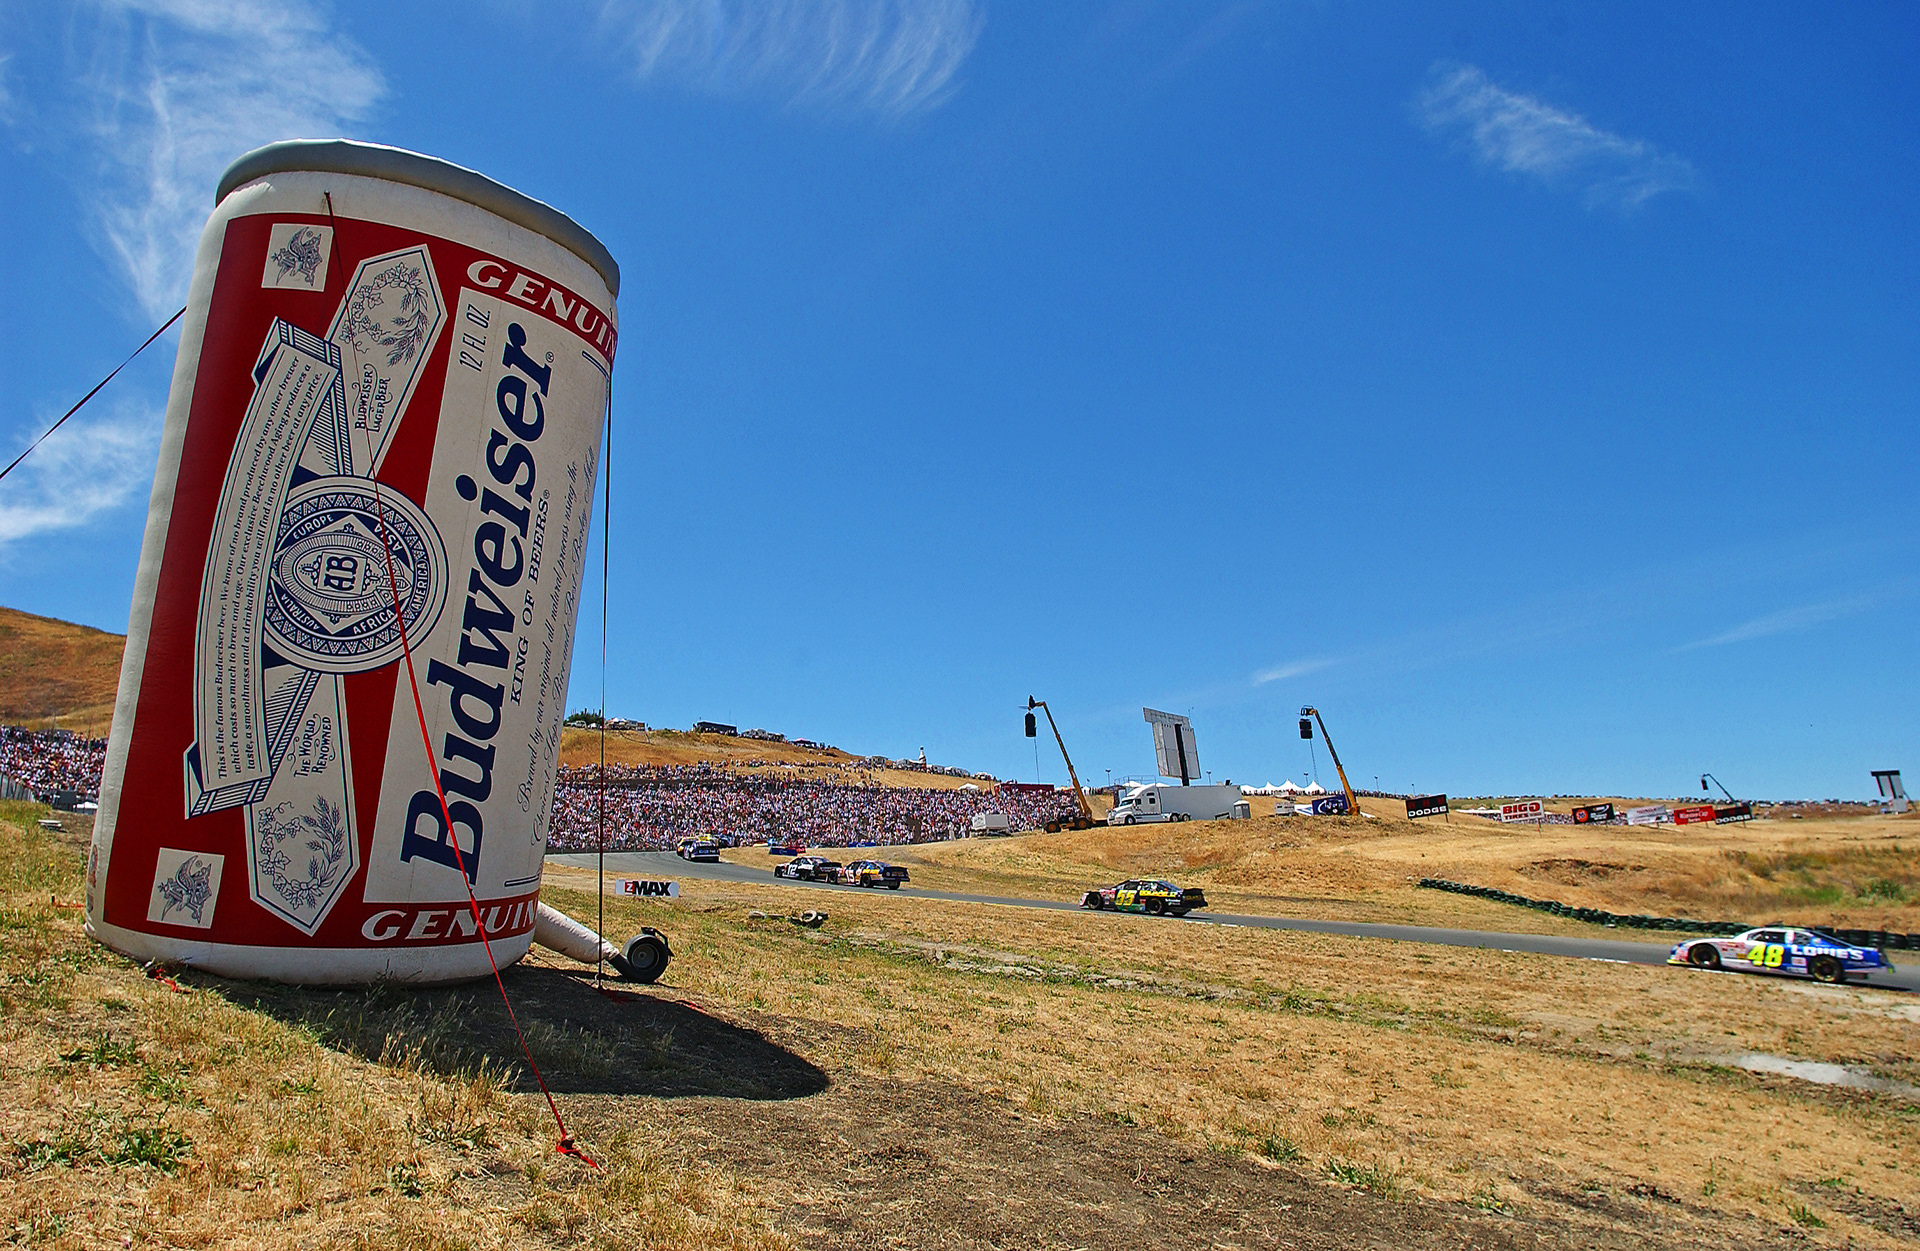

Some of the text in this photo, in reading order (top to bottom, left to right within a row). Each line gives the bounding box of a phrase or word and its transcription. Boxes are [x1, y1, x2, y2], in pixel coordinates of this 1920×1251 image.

[459, 303, 491, 372] 12 FL. OZ.
[306, 373, 323, 400] price.
[354, 370, 374, 429] BUDWEISER
[297, 398, 310, 418] any
[366, 377, 391, 433] LAGER BEER
[292, 418, 301, 430] at
[282, 430, 295, 452] beer
[274, 452, 287, 480] other
[567, 460, 578, 483] the
[265, 496, 274, 507] in
[270, 481, 279, 495] no
[564, 484, 577, 522] using
[259, 506, 270, 528] find
[292, 514, 335, 540] EUROPE
[255, 529, 266, 550] will
[374, 522, 403, 551] ASIA
[215, 356, 299, 779] This is the famous Budweiser beer. We know of no brand produced by any other brewer
[228, 364, 312, 773] which costs so much to brew and age. Our exclusive Beechwood Aging produces a
[252, 551, 261, 572] you
[414, 562, 428, 610] AMERICA
[550, 567, 562, 622] natural
[242, 573, 259, 634] drinkability
[280, 592, 321, 631] AUSTRALIA
[400, 322, 552, 887] Budweiser
[510, 497, 549, 707] KING OF BEERS
[352, 609, 395, 635] AFRICA
[544, 618, 555, 643] all
[242, 644, 250, 665] and
[540, 641, 552, 697] original
[241, 667, 251, 730] smoothness
[536, 699, 545, 723] our
[294, 719, 316, 778] THE WORLD
[311, 716, 332, 774] RENOWNED
[529, 727, 544, 745] by
[245, 741, 255, 770] taste,
[517, 743, 538, 812] Brewed
[530, 769, 551, 846] Choicest
[1408, 805, 1448, 818] DODGE
[1716, 814, 1751, 824] DODGE
[787, 864, 798, 875] 12
[845, 869, 856, 884] 15
[1115, 890, 1137, 906] 55
[1746, 944, 1785, 968] 48
